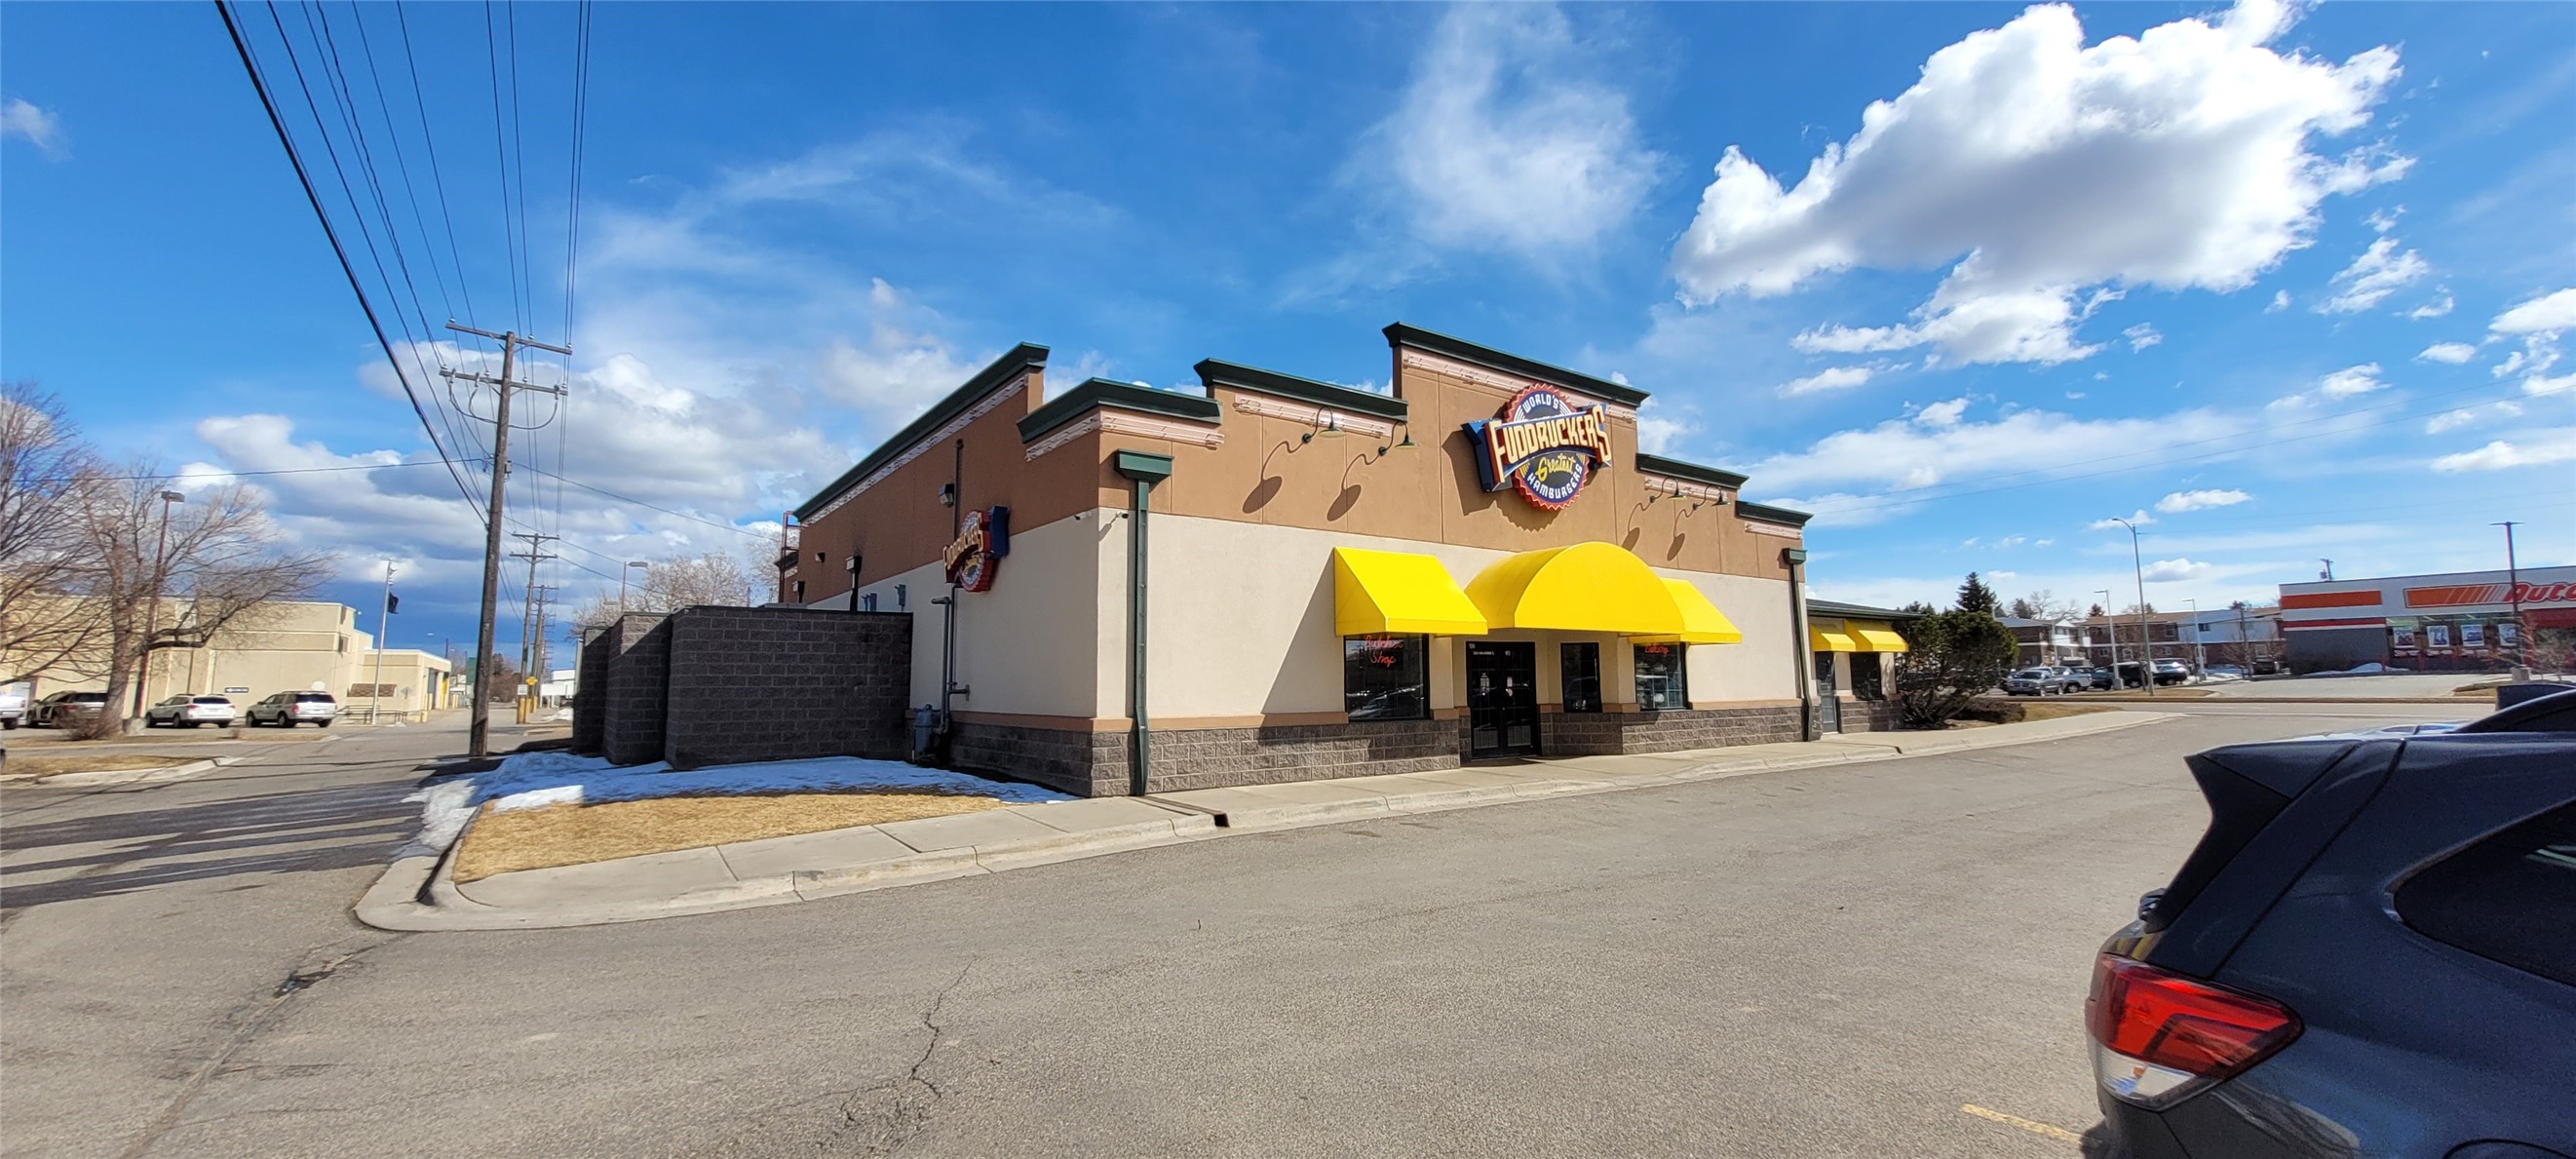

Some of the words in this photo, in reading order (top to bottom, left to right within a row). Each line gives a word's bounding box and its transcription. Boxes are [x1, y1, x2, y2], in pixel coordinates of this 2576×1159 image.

[1522, 393, 1559, 413] WORLD'S
[1489, 404, 1612, 483] FUDDRUCKERS
[1526, 462, 1583, 499] HAMBURGERS
[1535, 453, 1576, 482] Greatest
